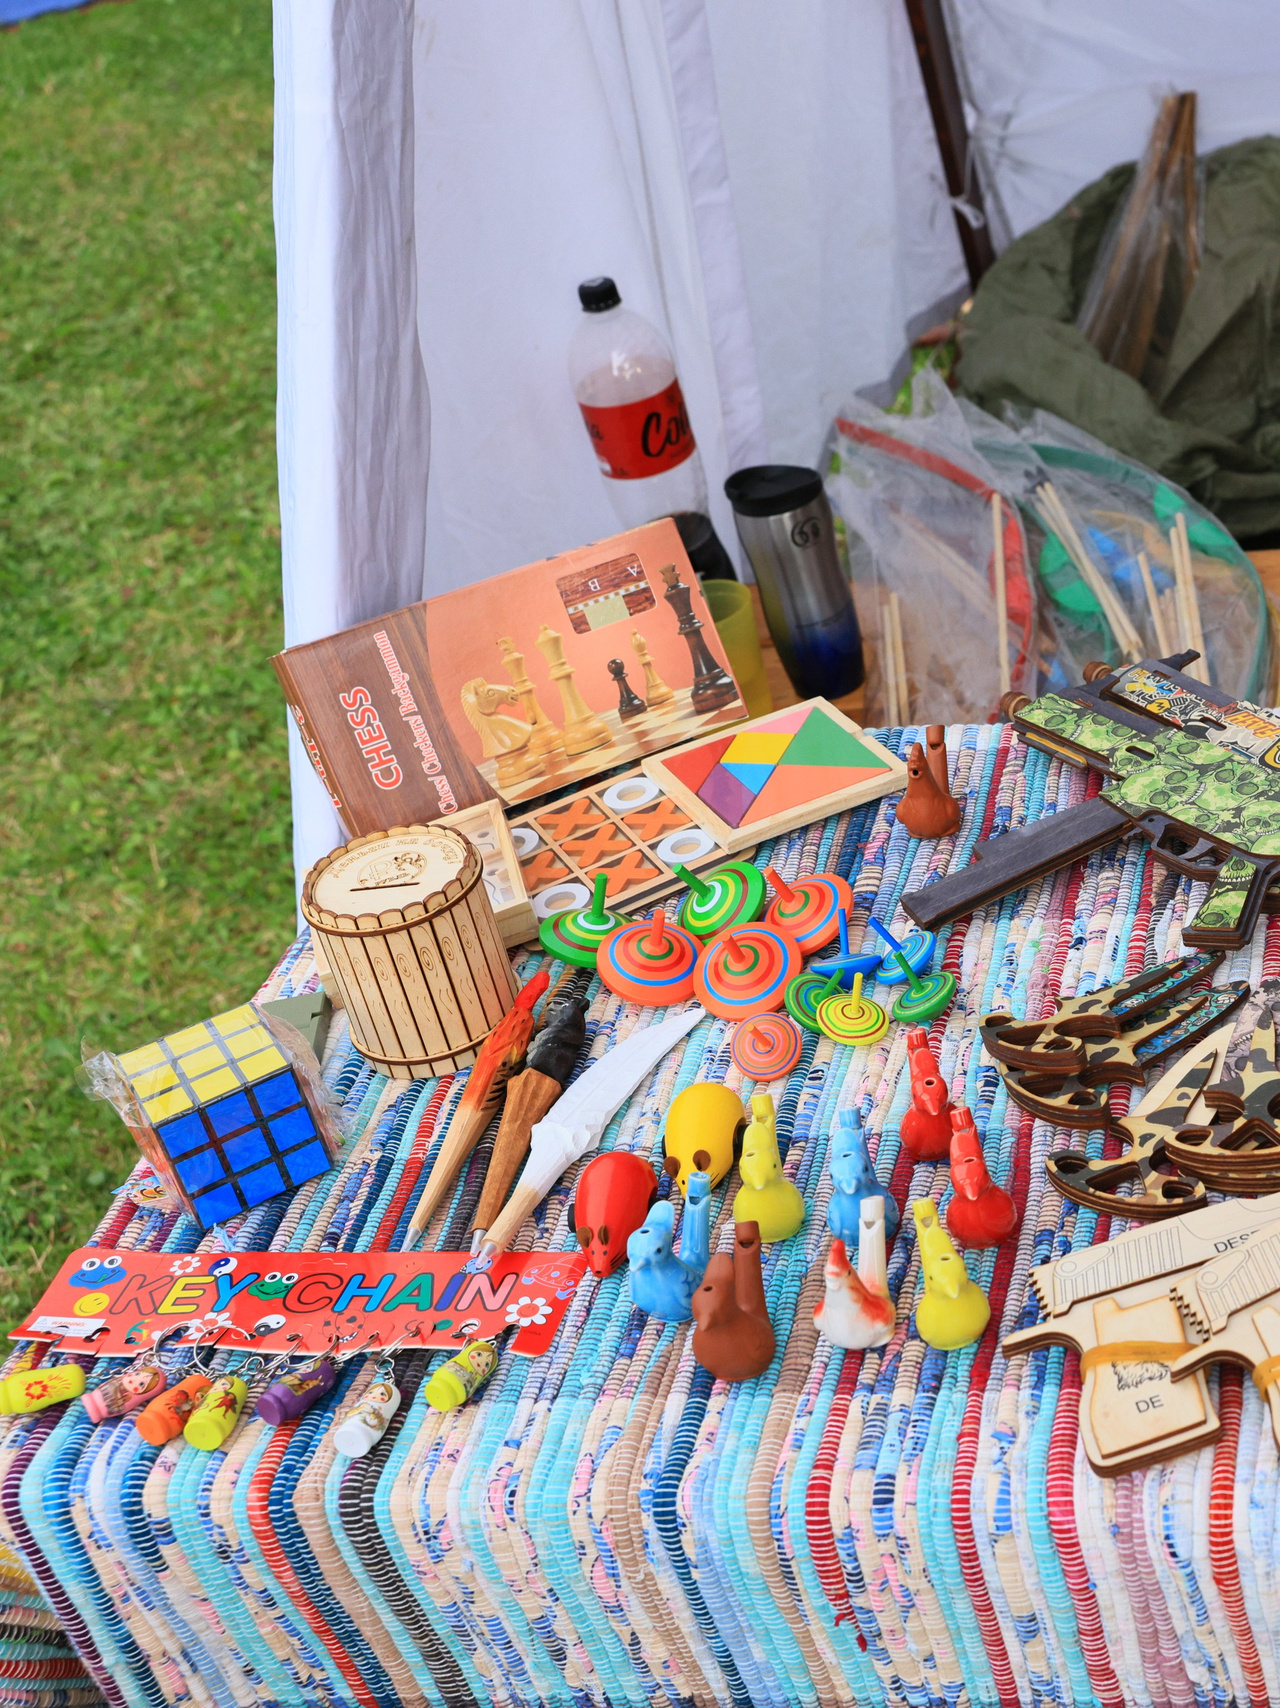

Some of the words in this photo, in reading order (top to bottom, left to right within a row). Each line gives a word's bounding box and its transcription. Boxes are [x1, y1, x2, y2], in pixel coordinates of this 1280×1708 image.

[373, 630, 418, 715] Backgammon
[340, 686, 403, 790] CHESS
[403, 715, 442, 775] Checkers/
[428, 774, 458, 814] Chess/
[1213, 1229, 1261, 1254] DES
[108, 1272, 261, 1316] KEY
[283, 1271, 520, 1315] CHAIN
[1135, 1395, 1164, 1414] DE
